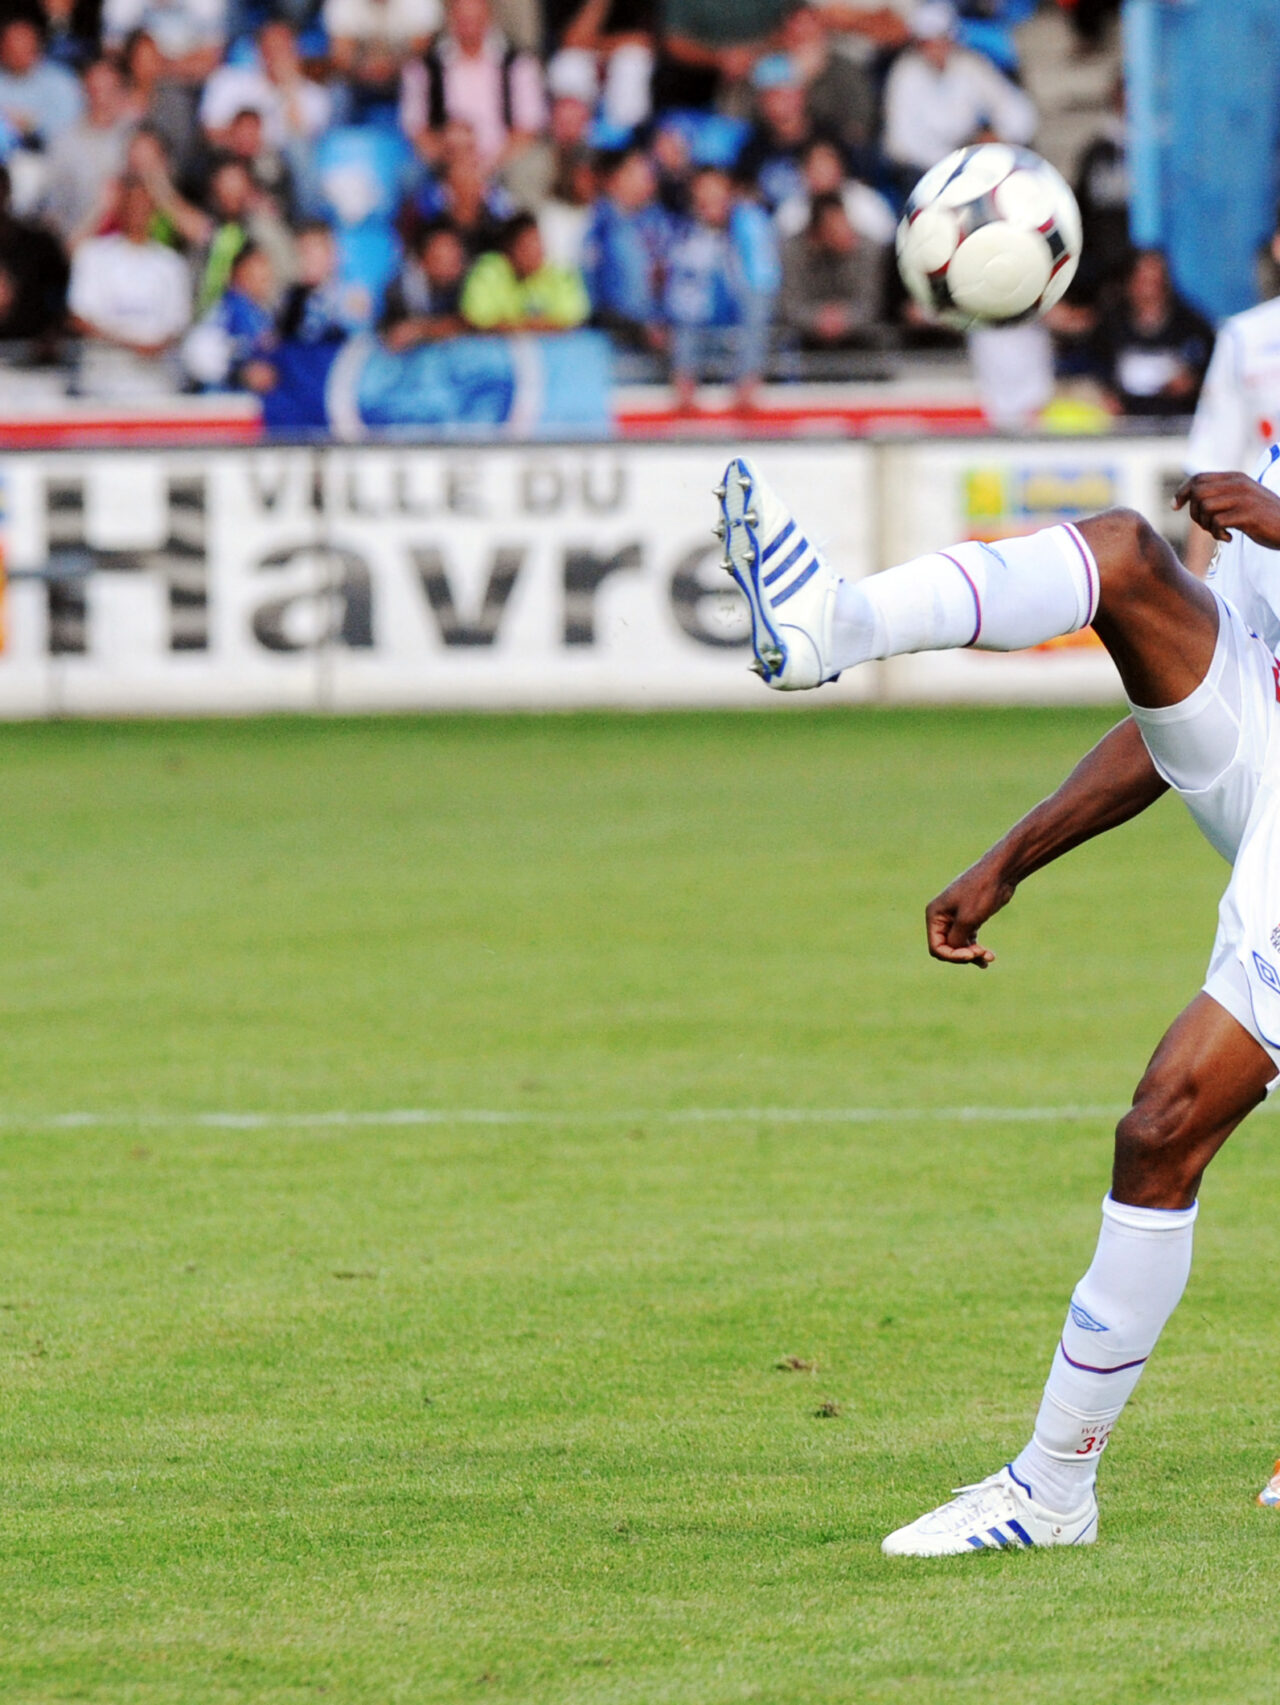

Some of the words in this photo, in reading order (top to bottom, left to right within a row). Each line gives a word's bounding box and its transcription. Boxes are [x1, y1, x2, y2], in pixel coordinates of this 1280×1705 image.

[249, 457, 488, 513] VILLE
[521, 457, 628, 513] DU
[45, 476, 757, 652] Havre
